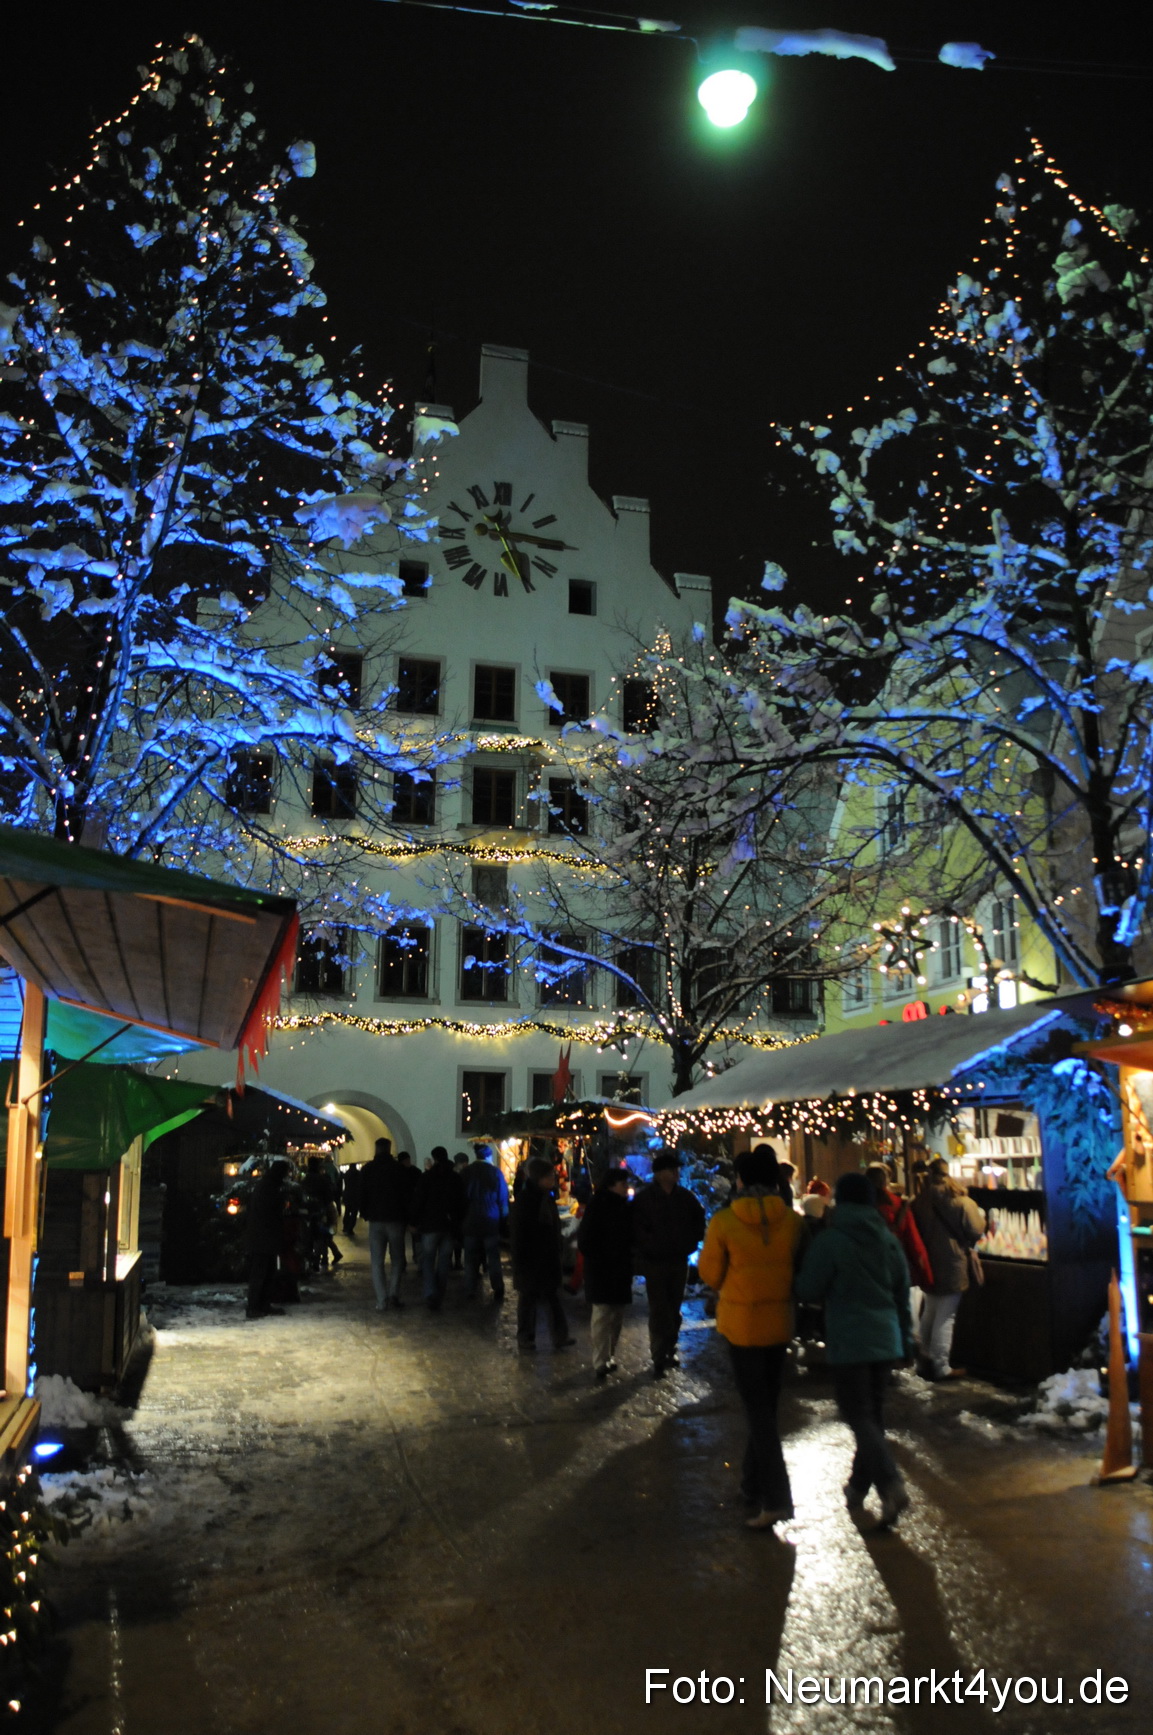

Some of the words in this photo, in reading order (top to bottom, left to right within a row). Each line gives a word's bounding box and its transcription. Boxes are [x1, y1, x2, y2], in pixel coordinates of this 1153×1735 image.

[466, 484, 490, 510] XI
[493, 481, 513, 507] XII
[519, 493, 536, 513] I
[446, 501, 473, 522] X
[532, 514, 558, 529] II
[438, 525, 466, 540] IX
[442, 544, 474, 571] VIII
[461, 562, 488, 590] VII
[493, 571, 509, 598] VI
